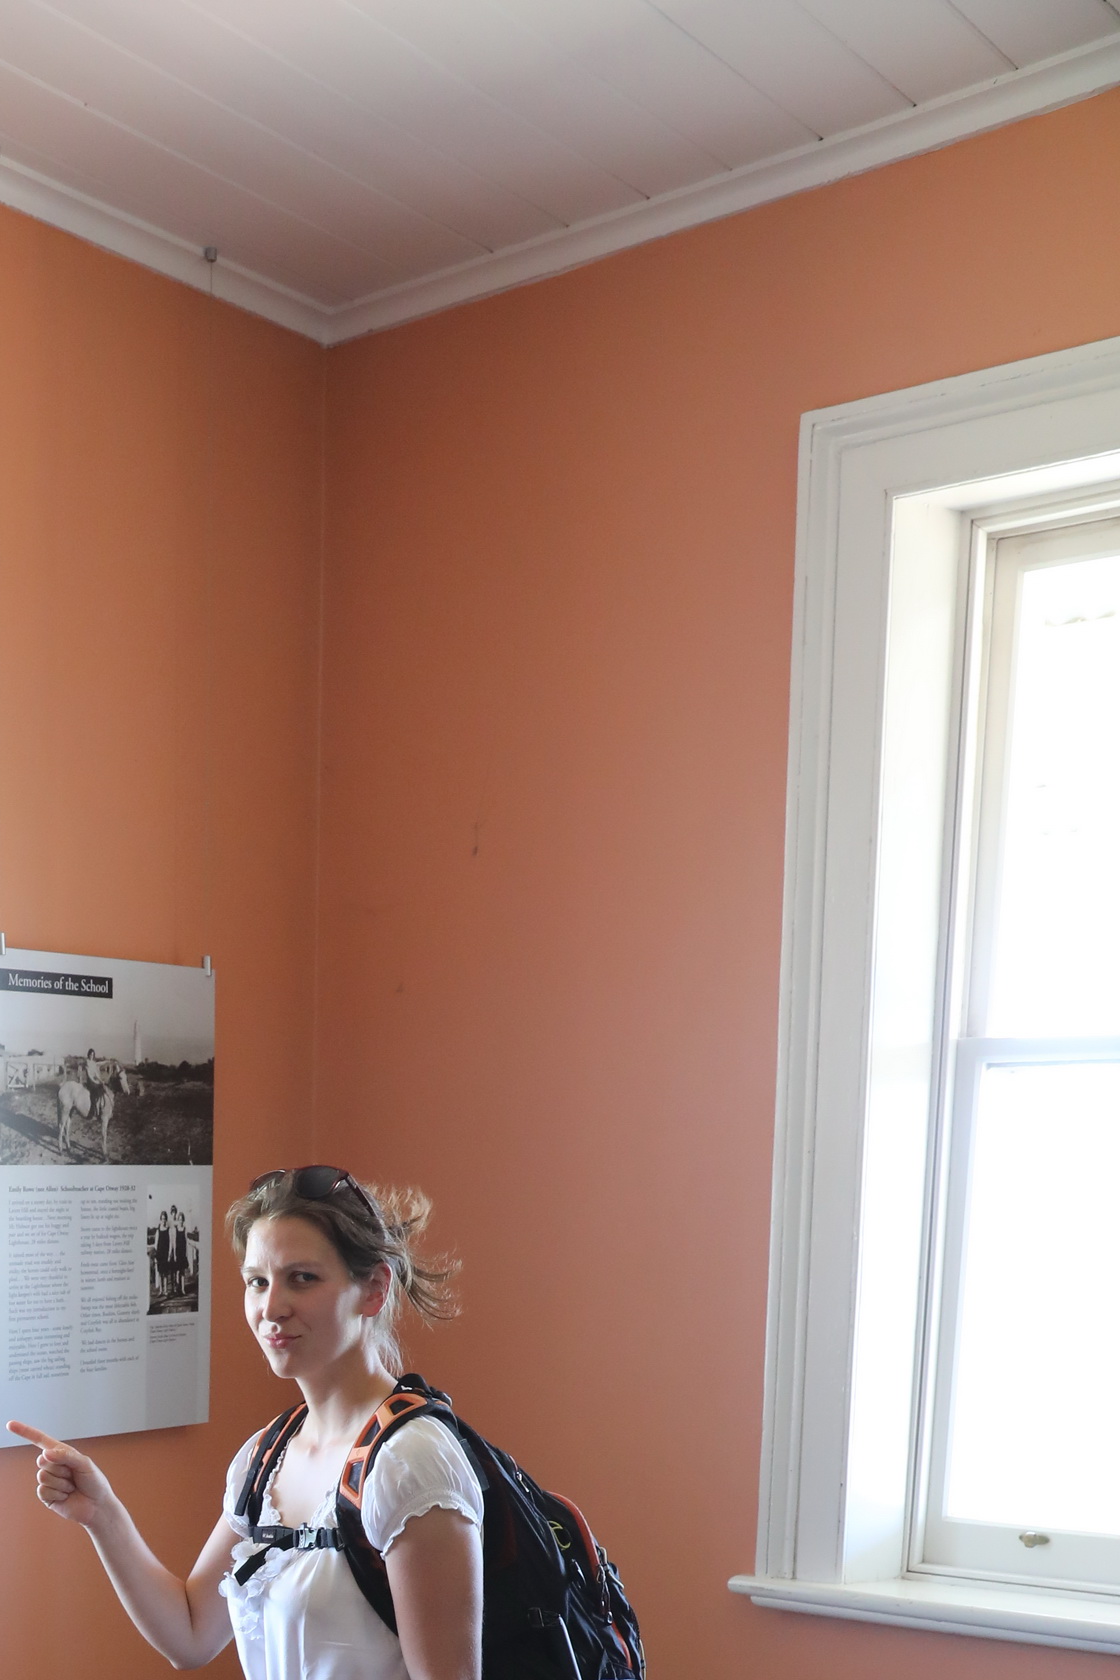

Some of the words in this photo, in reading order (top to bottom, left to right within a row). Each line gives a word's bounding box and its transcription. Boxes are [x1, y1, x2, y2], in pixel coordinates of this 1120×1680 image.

[8, 973, 52, 989] Memories
[54, 976, 64, 990] of
[65, 978, 79, 991] the
[80, 979, 109, 993] School
